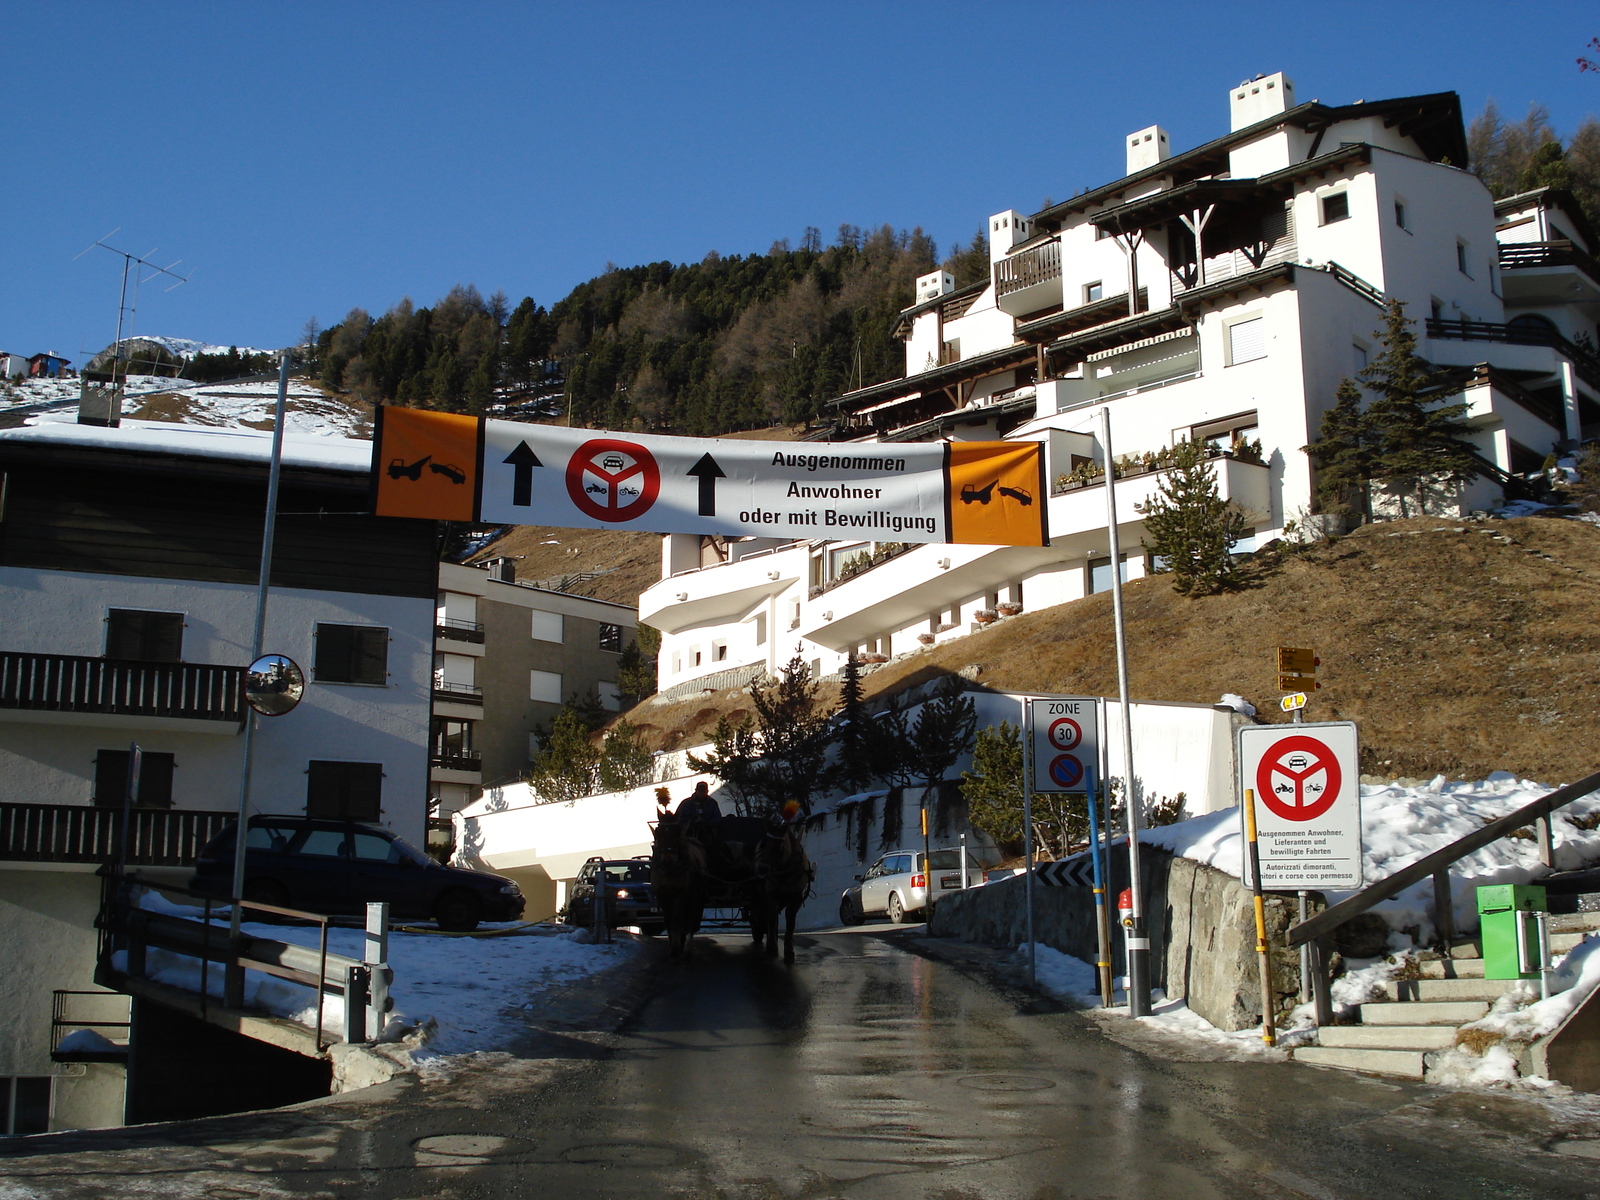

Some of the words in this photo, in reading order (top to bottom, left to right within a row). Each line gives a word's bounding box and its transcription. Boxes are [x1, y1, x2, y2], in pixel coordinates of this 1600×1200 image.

[772, 451, 906, 471] Ausgenommen
[787, 481, 882, 499] Anwohner
[739, 508, 781, 524] oder
[788, 510, 818, 525] mit
[825, 509, 936, 533] Bewilligung
[1049, 703, 1080, 714] ZONE
[1059, 728, 1072, 740] 30
[1257, 830, 1306, 838] Ausgenommen
[1307, 829, 1344, 837] Anwohner,
[1274, 838, 1312, 846] Lieferanten
[1270, 848, 1304, 857] bewilligte
[1303, 863, 1337, 871] dimoranti,
